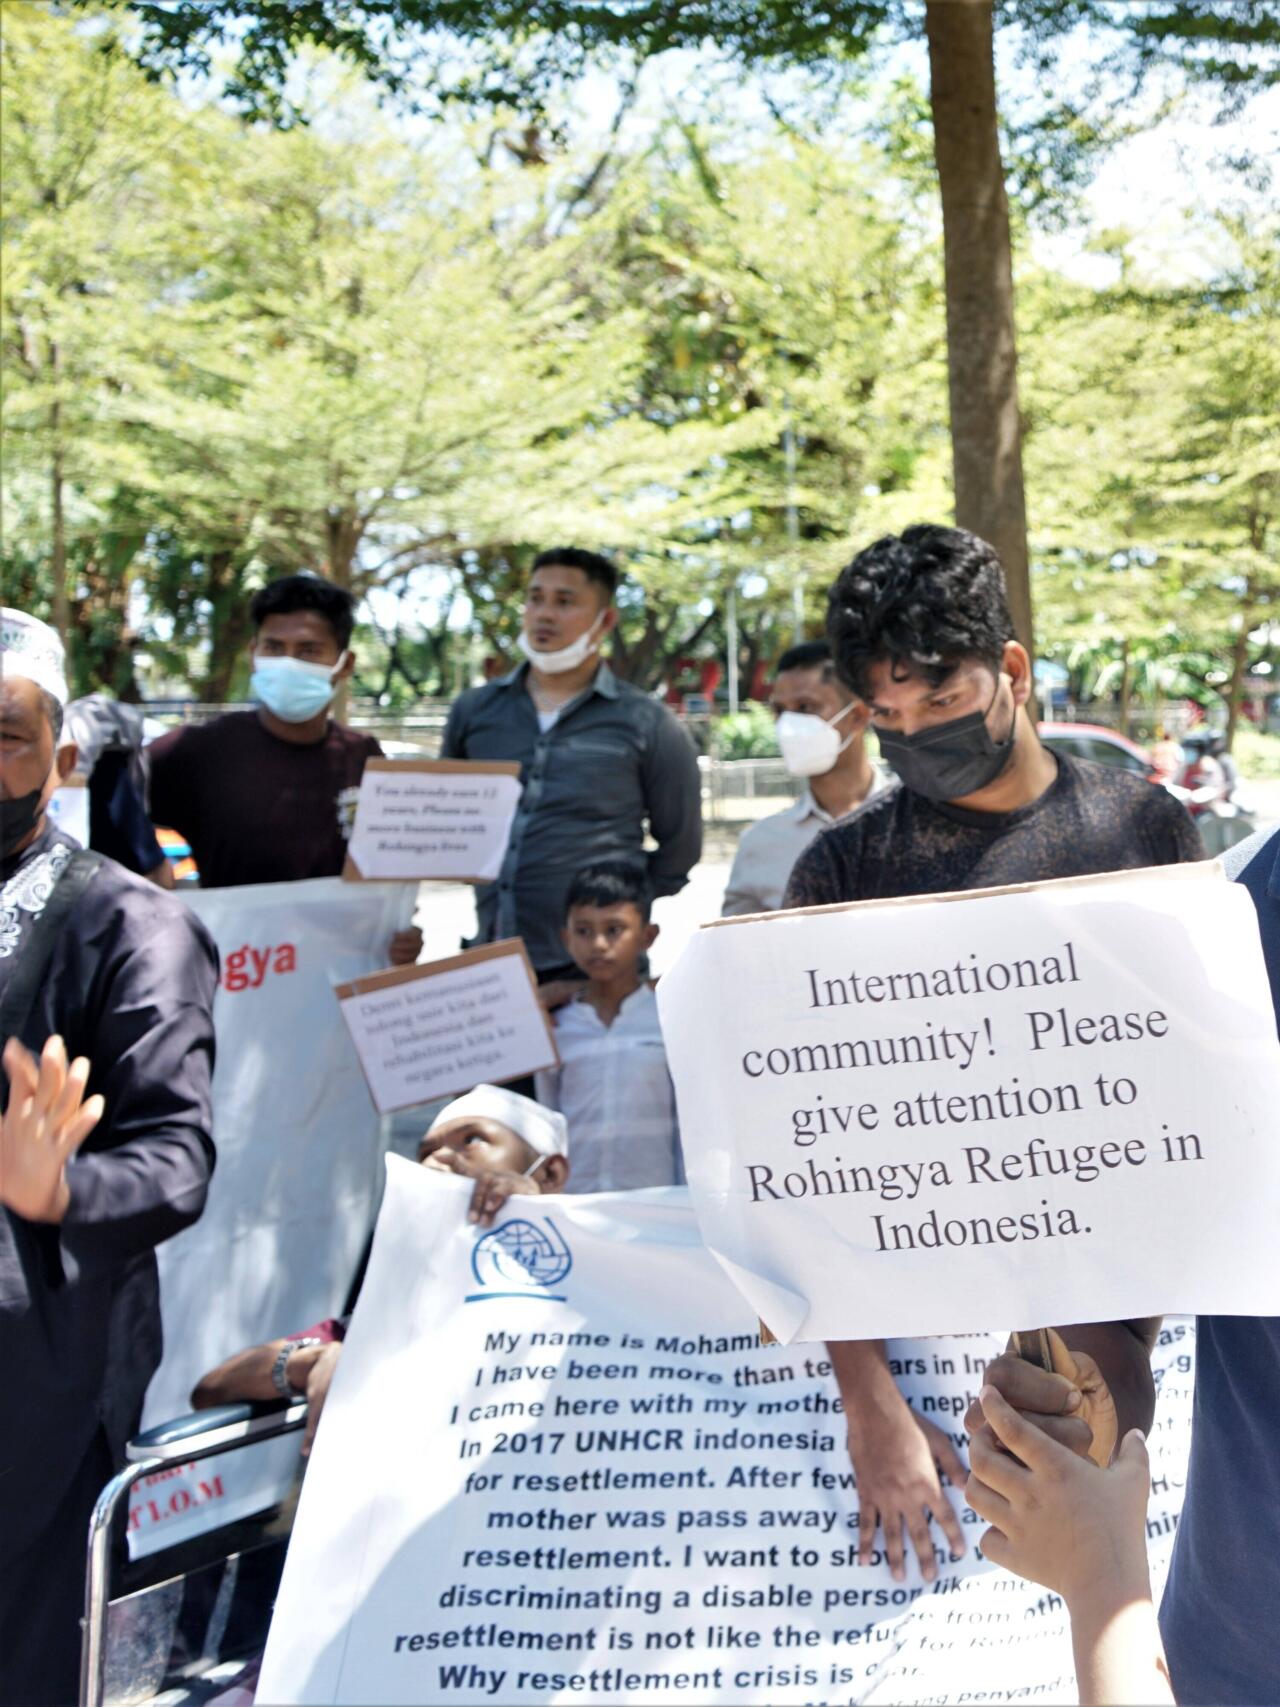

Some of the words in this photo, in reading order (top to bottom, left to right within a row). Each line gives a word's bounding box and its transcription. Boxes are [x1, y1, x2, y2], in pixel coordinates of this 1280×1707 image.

[222, 943, 297, 992] gya
[805, 942, 1081, 1008] International
[742, 1017, 997, 1078] community!
[1024, 1007, 1169, 1052] Please
[791, 1095, 880, 1147] give
[893, 1077, 1083, 1129] attention
[1094, 1072, 1138, 1105] to
[745, 1156, 953, 1203] Rohingya
[961, 1138, 1147, 1185] Refugee
[1160, 1124, 1206, 1163] in
[870, 1200, 1093, 1252] Indonesia.
[484, 1331, 522, 1354] My
[529, 1331, 610, 1349] name
[621, 1332, 645, 1350] is
[474, 1368, 483, 1387] I
[492, 1363, 558, 1385] have
[567, 1359, 638, 1380] been
[648, 1366, 723, 1385] more
[734, 1364, 795, 1387] than
[804, 1358, 832, 1378] te
[888, 1358, 927, 1376] ars
[932, 1354, 955, 1375] in
[450, 1405, 459, 1424] I
[469, 1401, 545, 1422] came
[554, 1395, 619, 1417] here
[630, 1393, 694, 1414] with
[703, 1398, 747, 1418] my
[757, 1391, 844, 1416] mothe
[460, 1439, 482, 1459] In
[491, 1431, 566, 1455] 2017
[575, 1427, 683, 1453] UNHCR
[693, 1427, 834, 1452] indonesia
[465, 1473, 503, 1494] for
[512, 1469, 716, 1492] resettlement.
[726, 1466, 802, 1490] After
[486, 1508, 597, 1532] mother
[605, 1508, 666, 1529] was
[676, 1508, 748, 1533] pass
[758, 1509, 837, 1534] away
[462, 1545, 672, 1571] resettlement.
[683, 1545, 693, 1568] I
[704, 1545, 779, 1568] want
[790, 1544, 819, 1567] to
[439, 1585, 662, 1614] discriminating
[672, 1590, 691, 1609] a
[702, 1584, 813, 1610] disable
[824, 1585, 922, 1613] person
[393, 1623, 597, 1653] resettlement
[608, 1628, 633, 1650] is
[644, 1628, 696, 1651] not
[706, 1626, 762, 1650] like
[773, 1625, 821, 1648] the
[946, 1609, 1010, 1625] from
[1023, 1594, 1063, 1621] oth
[438, 1665, 508, 1695] Why
[516, 1667, 722, 1692] resettlement
[734, 1663, 818, 1688] crisis
[830, 1662, 853, 1685] is
[957, 1676, 1073, 1705] penyand
